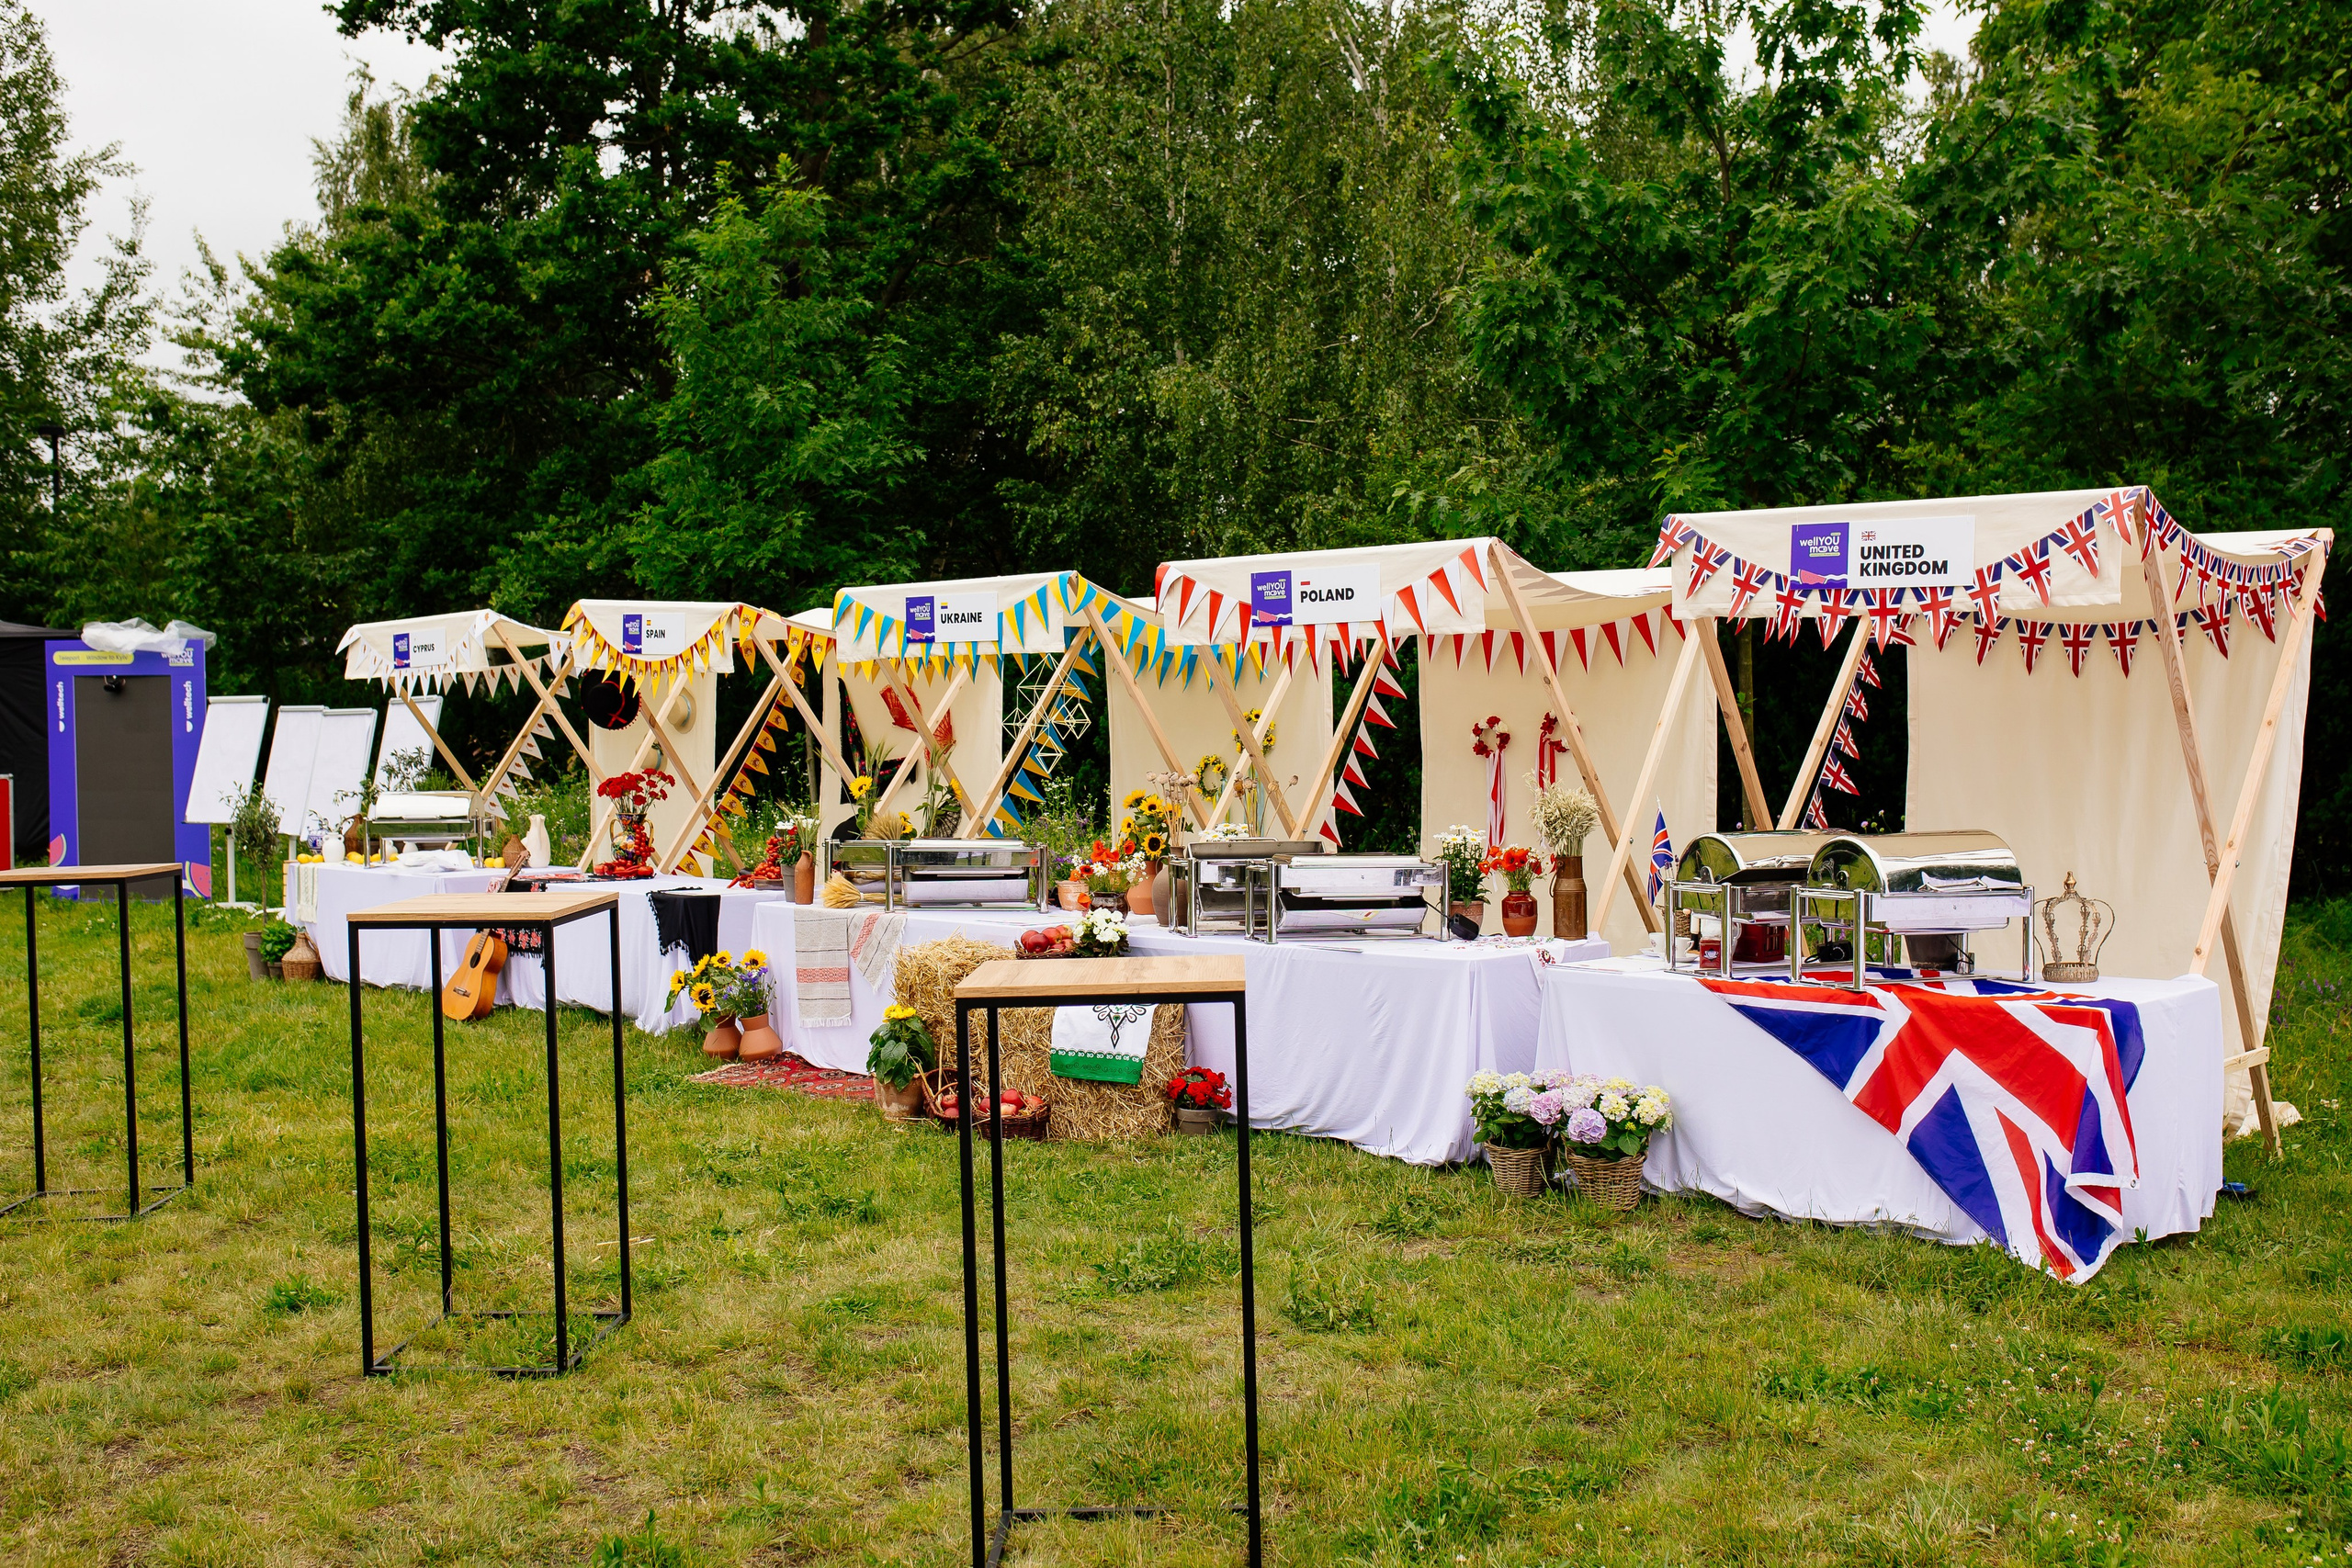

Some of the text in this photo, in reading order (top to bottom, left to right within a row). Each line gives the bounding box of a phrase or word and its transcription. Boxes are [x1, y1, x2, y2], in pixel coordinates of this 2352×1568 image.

[1799, 536, 1840, 547] wellYOU
[1860, 544, 1925, 560] UNITED
[1860, 559, 1949, 577] KINGDOM
[1256, 581, 1286, 592] wellYOU
[1300, 587, 1355, 604] POLAND
[940, 611, 983, 625] UKRAINE
[645, 629, 666, 638] SPAIN
[413, 643, 435, 653] CYPRUS
[115, 653, 129, 662] Kyiv
[183, 680, 193, 720] welltech
